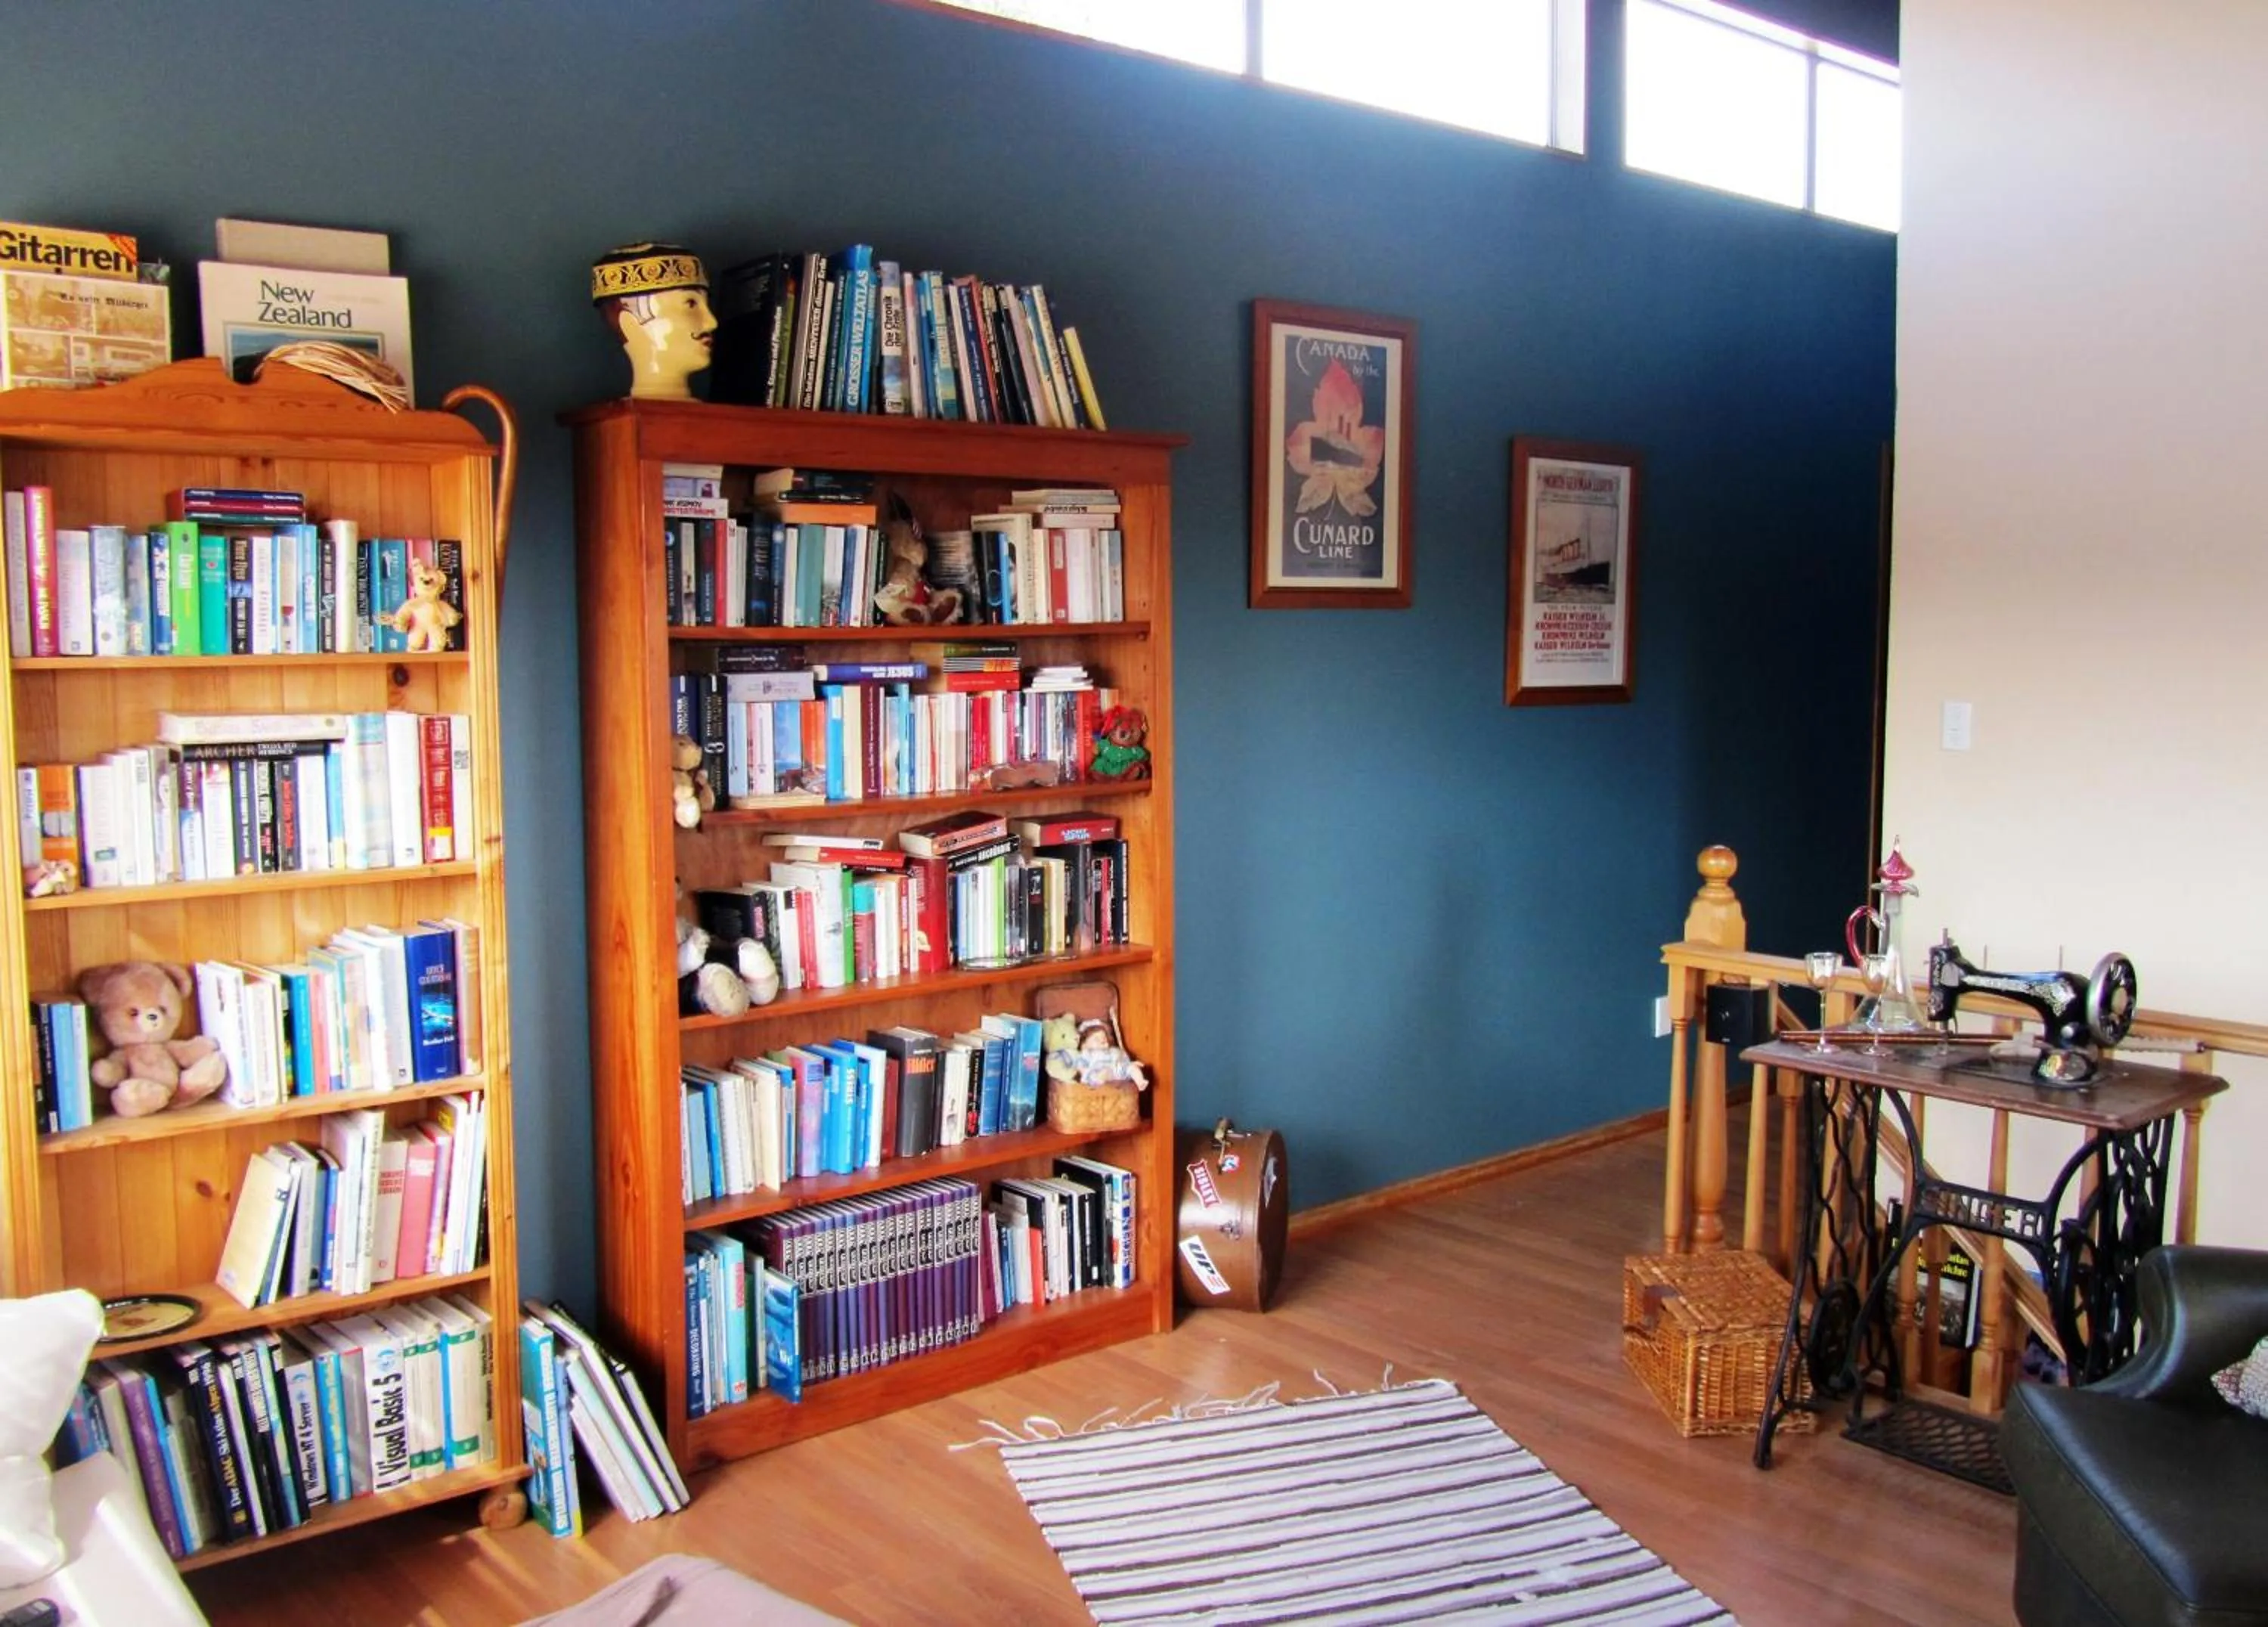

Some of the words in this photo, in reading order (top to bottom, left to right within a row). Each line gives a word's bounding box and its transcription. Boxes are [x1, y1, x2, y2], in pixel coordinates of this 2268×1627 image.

[0, 229, 134, 273] Gitarren
[261, 279, 314, 303] New
[851, 270, 869, 345] WELTATLAS
[258, 302, 352, 328] Zealand
[883, 296, 893, 330] Chronik
[884, 331, 894, 347] Die
[1295, 337, 1370, 377] CANADA
[846, 347, 862, 406] GROSSER
[1294, 517, 1374, 553] CUNARD
[1319, 545, 1353, 559] LINE
[194, 745, 256, 758] ARCHER
[1923, 1187, 2043, 1238] SINGER
[372, 1373, 401, 1386] 5
[297, 1401, 311, 1430] Server
[372, 1387, 404, 1428] Basic
[302, 1440, 314, 1452] NT
[373, 1427, 407, 1476] Visual
[222, 1455, 237, 1488] ADAC
[302, 1452, 318, 1491] Windows
[229, 1488, 243, 1507] Der
